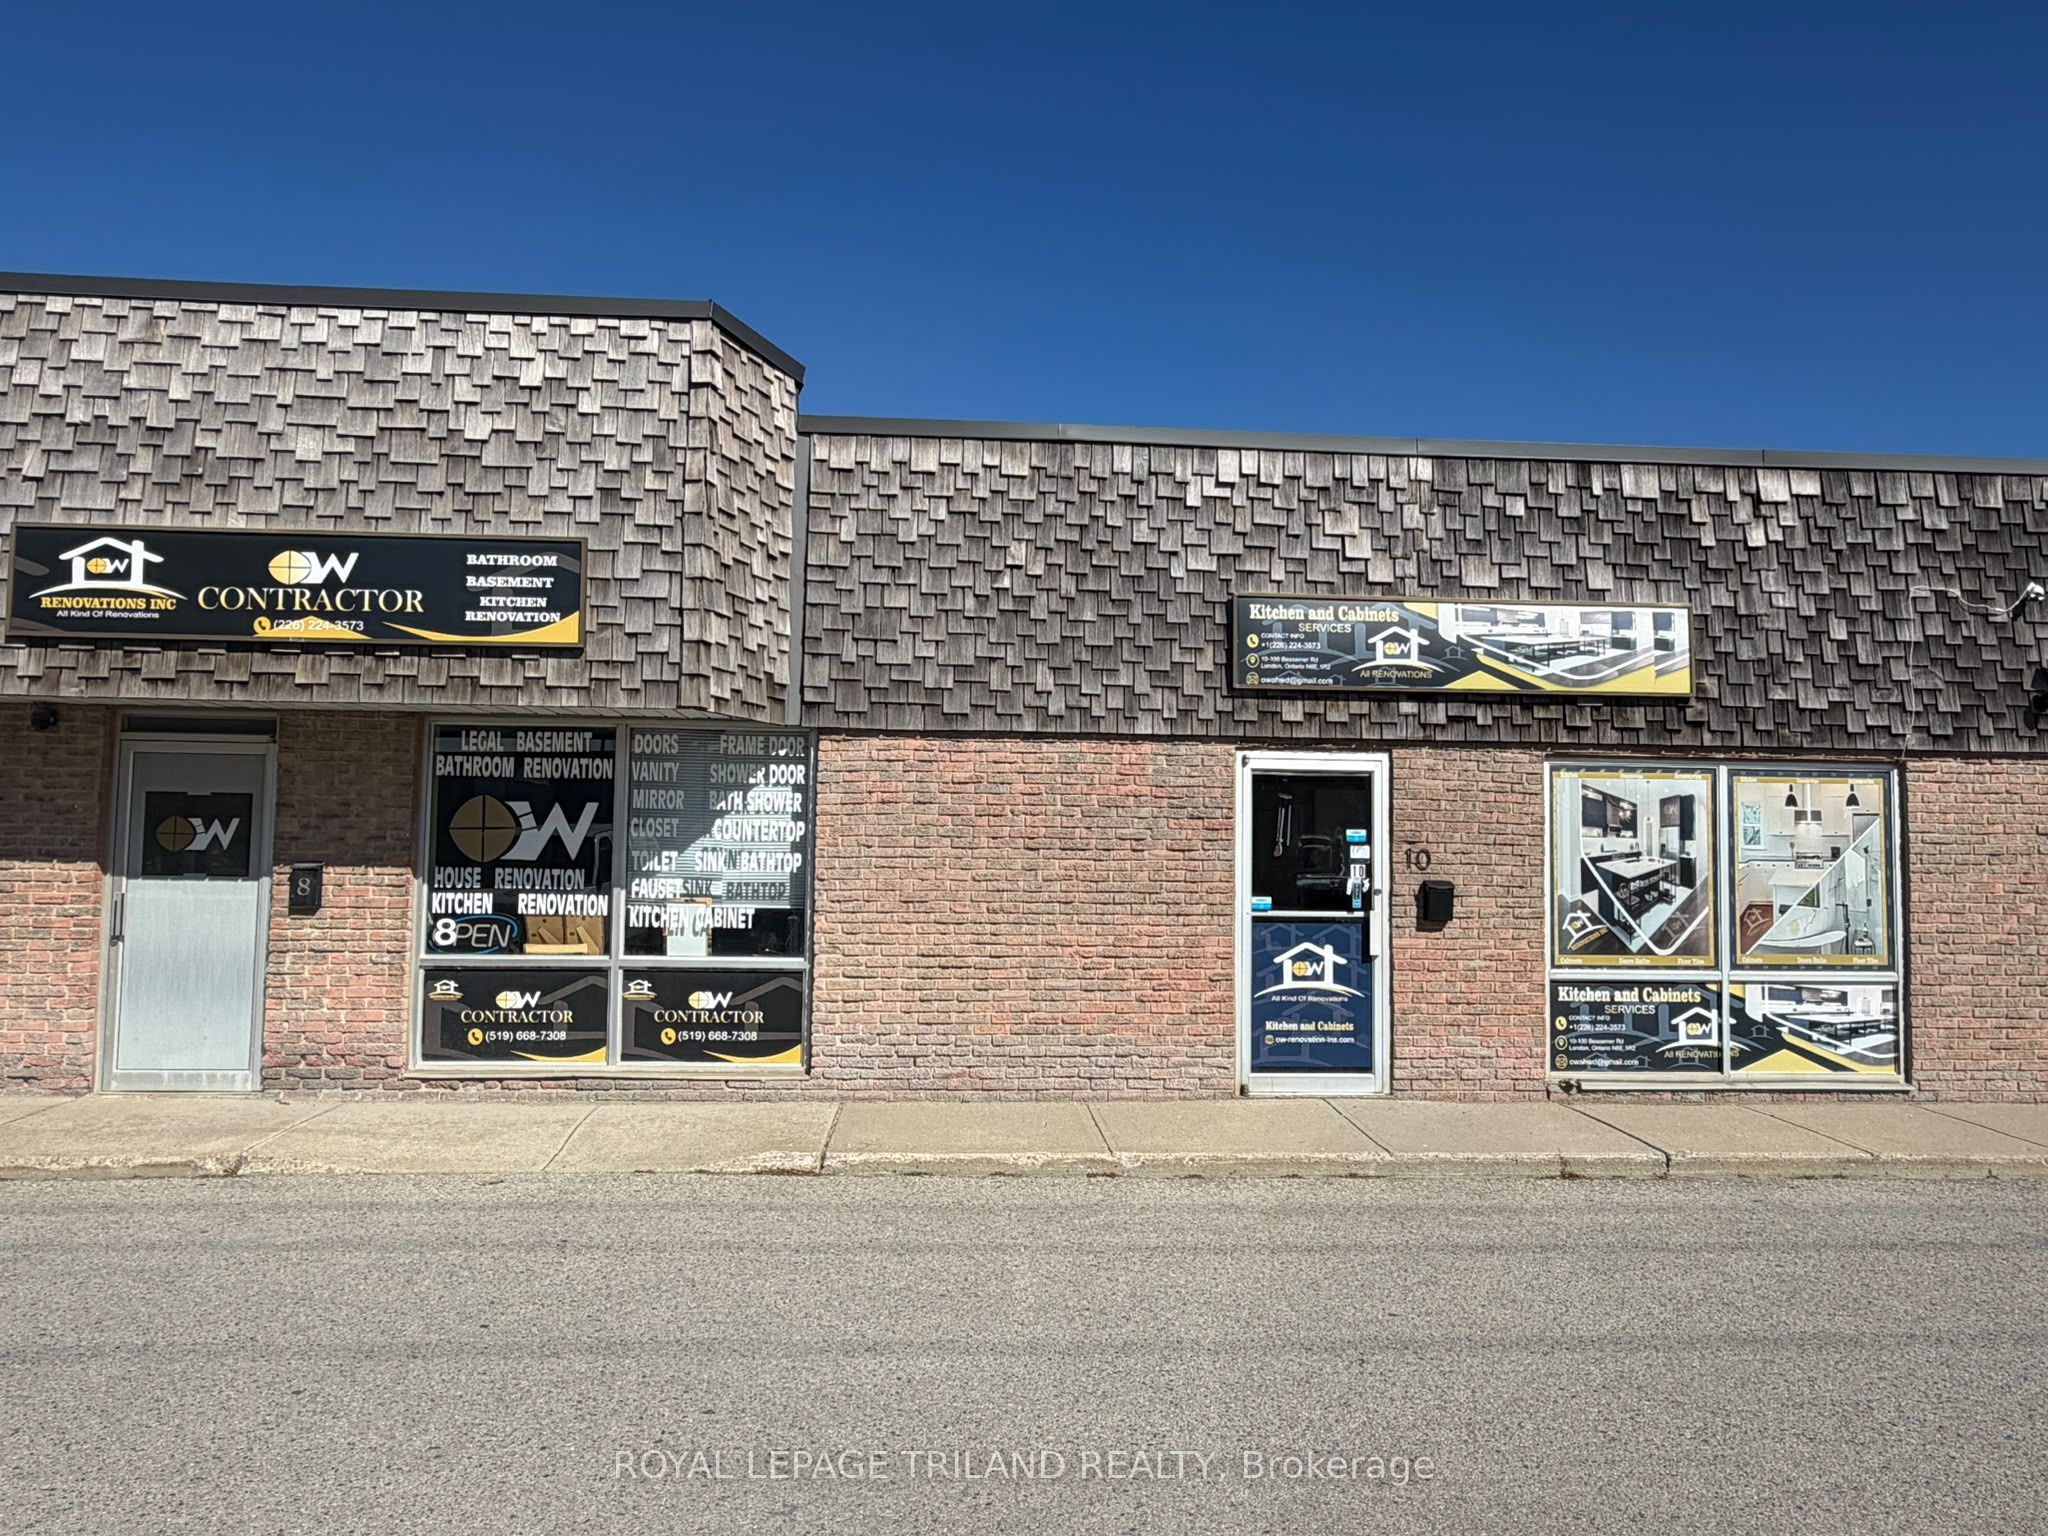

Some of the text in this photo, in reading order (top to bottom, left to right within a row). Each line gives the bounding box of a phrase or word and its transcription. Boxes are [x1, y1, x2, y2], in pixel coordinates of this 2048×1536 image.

[466, 554, 558, 566] BATHROOM
[466, 576, 554, 588] BASEMENT
[40, 596, 177, 610] RENOVATIONS INC
[198, 586, 424, 613] CONTRACTOR
[479, 596, 548, 607] KITCHEN
[56, 610, 160, 619] All Kind Of Renovations
[465, 611, 561, 623] RENOVATION
[1249, 604, 1399, 622] Kitchen and Cabinets
[273, 619, 364, 632] (226) 224-3573
[1298, 623, 1352, 633] SERVICES
[1360, 670, 1433, 679] All RENOVATIONS
[461, 730, 593, 753] LEGAL BASEMENT
[634, 734, 679, 754] DOORS
[719, 735, 805, 757] FRAME DOOR
[435, 755, 613, 779] BATHROOM RENOVATION
[631, 761, 679, 782] VANITY
[710, 763, 805, 785] SHOWER DOOR
[633, 789, 685, 809] MIRROR
[709, 791, 802, 813] BATH SHOWER
[630, 817, 679, 838] CLOSET
[713, 819, 806, 842] COUNTERTOP
[631, 851, 678, 872] TOILET
[695, 851, 802, 873] SINK BATHTOP
[1405, 847, 1431, 871] 10
[434, 866, 585, 890] HOUSE RENOVATION
[1352, 865, 1365, 878] 10
[296, 877, 311, 897] 8
[631, 878, 682, 899] FAUSET
[431, 892, 608, 916] KITCHEN RENOVATION
[629, 905, 755, 929] KITCHEN CABINET
[434, 918, 457, 946] 8
[434, 923, 511, 947] PEN
[1558, 986, 1701, 1003] Kitchen and Cabinets
[460, 1010, 574, 1024] CONTRACTOR
[654, 1010, 764, 1024] CONTRACTOR
[1604, 1005, 1656, 1014] SERVICES
[1265, 1021, 1354, 1031] Kitchen and Cabinets
[485, 1030, 567, 1043] (519) 668-7308
[678, 1030, 758, 1043] (519) 668-7308
